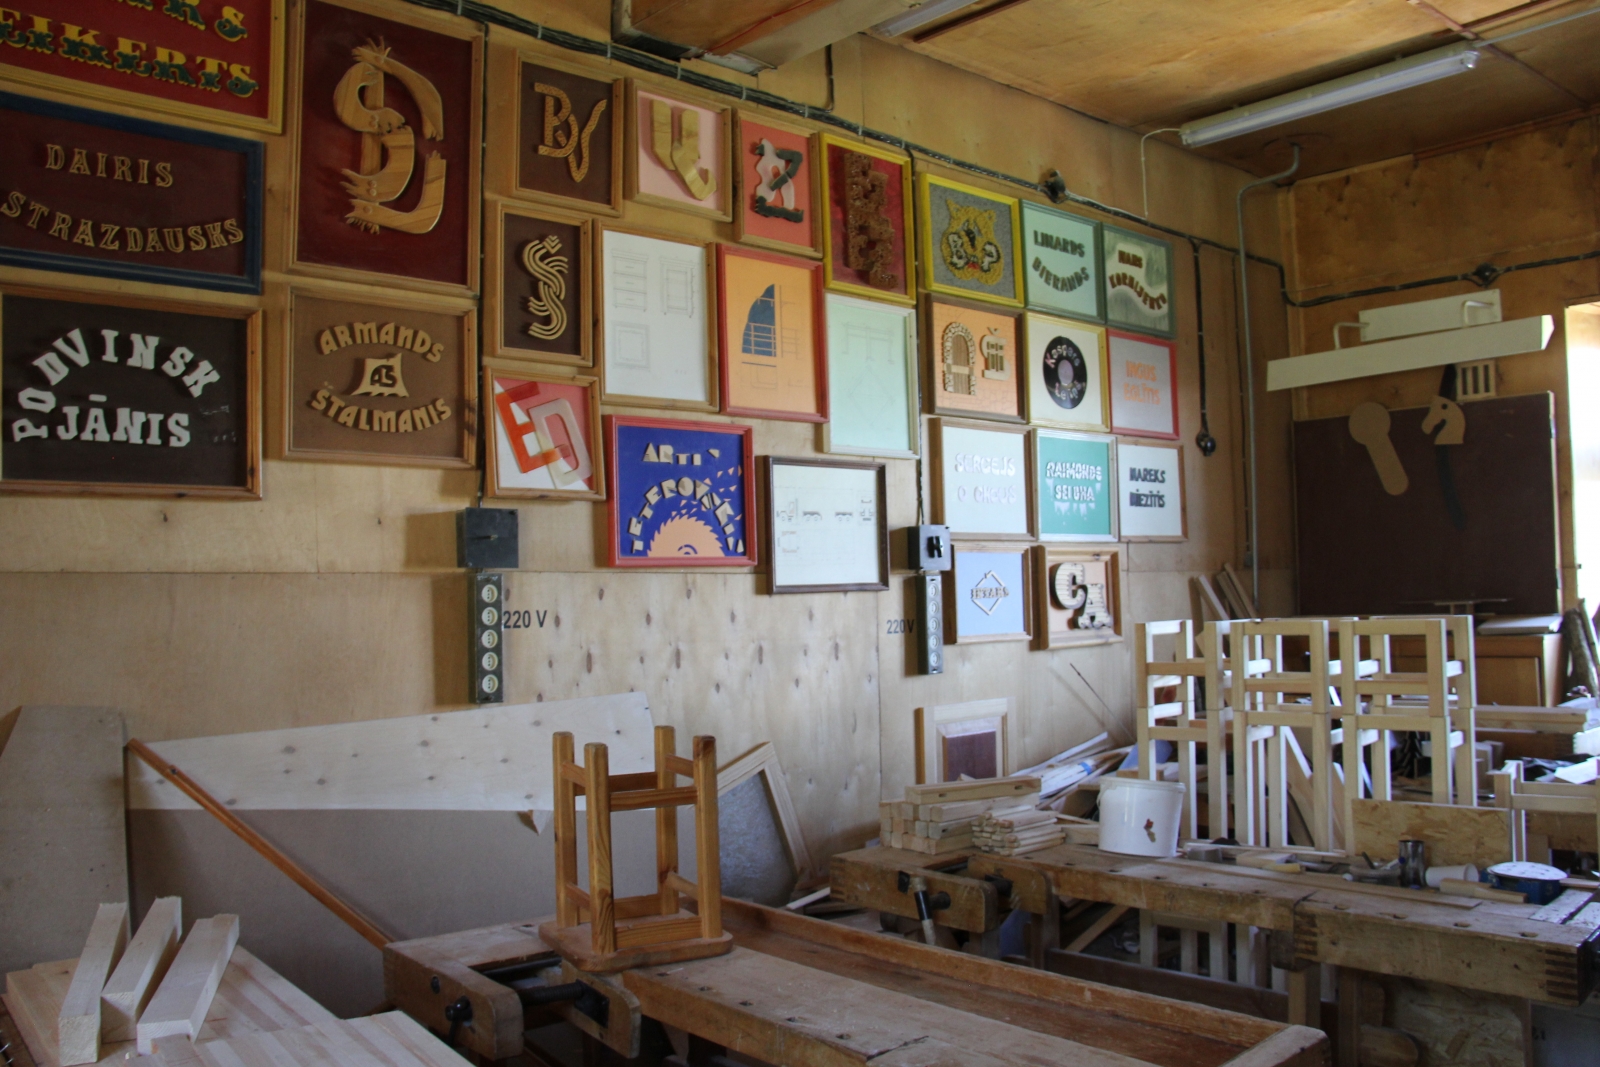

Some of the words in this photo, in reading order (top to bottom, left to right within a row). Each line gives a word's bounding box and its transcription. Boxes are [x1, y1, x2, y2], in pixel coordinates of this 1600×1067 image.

[46, 144, 173, 187] DAIRIS
[1, 191, 243, 252] STRAZDAUSKS
[1034, 230, 1085, 258] LINARDS
[320, 322, 444, 362] ARMANDS
[57, 394, 190, 447] JĀNIS
[1046, 461, 1102, 481] RAIMONDS
[1129, 467, 1166, 483] MAREKS
[503, 610, 531, 629] 220
